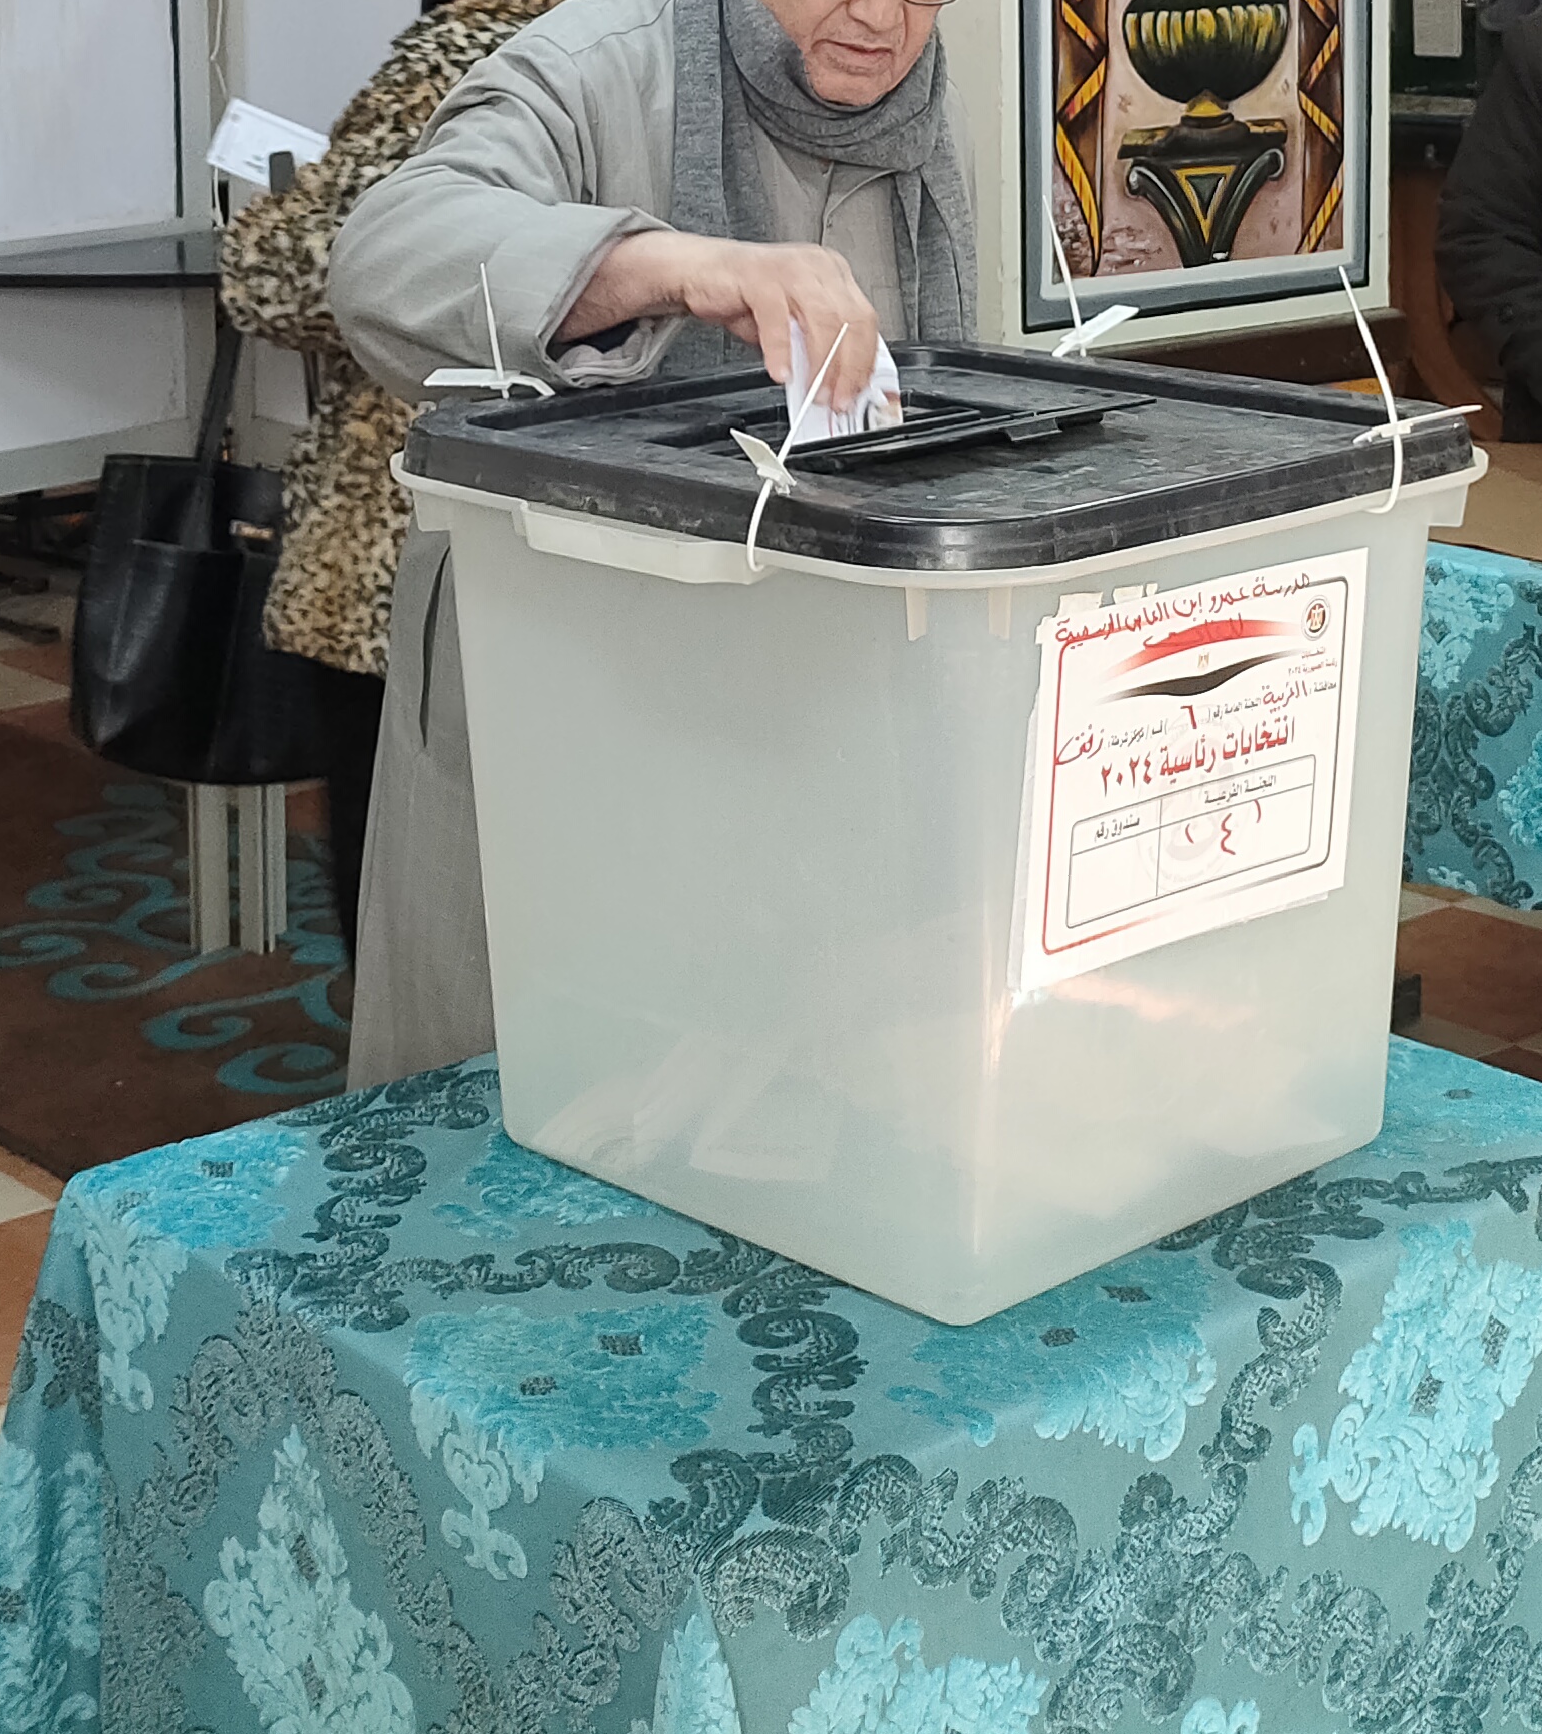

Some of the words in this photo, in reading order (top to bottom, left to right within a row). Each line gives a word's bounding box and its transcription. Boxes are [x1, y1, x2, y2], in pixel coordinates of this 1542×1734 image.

[1208, 587, 1250, 613] عمرو
[1253, 572, 1310, 597] مدرسة
[1159, 734, 1217, 785] رئاسية
[1222, 715, 1295, 765] انتخابات
[1100, 751, 1152, 797] ٢٠٢٤
